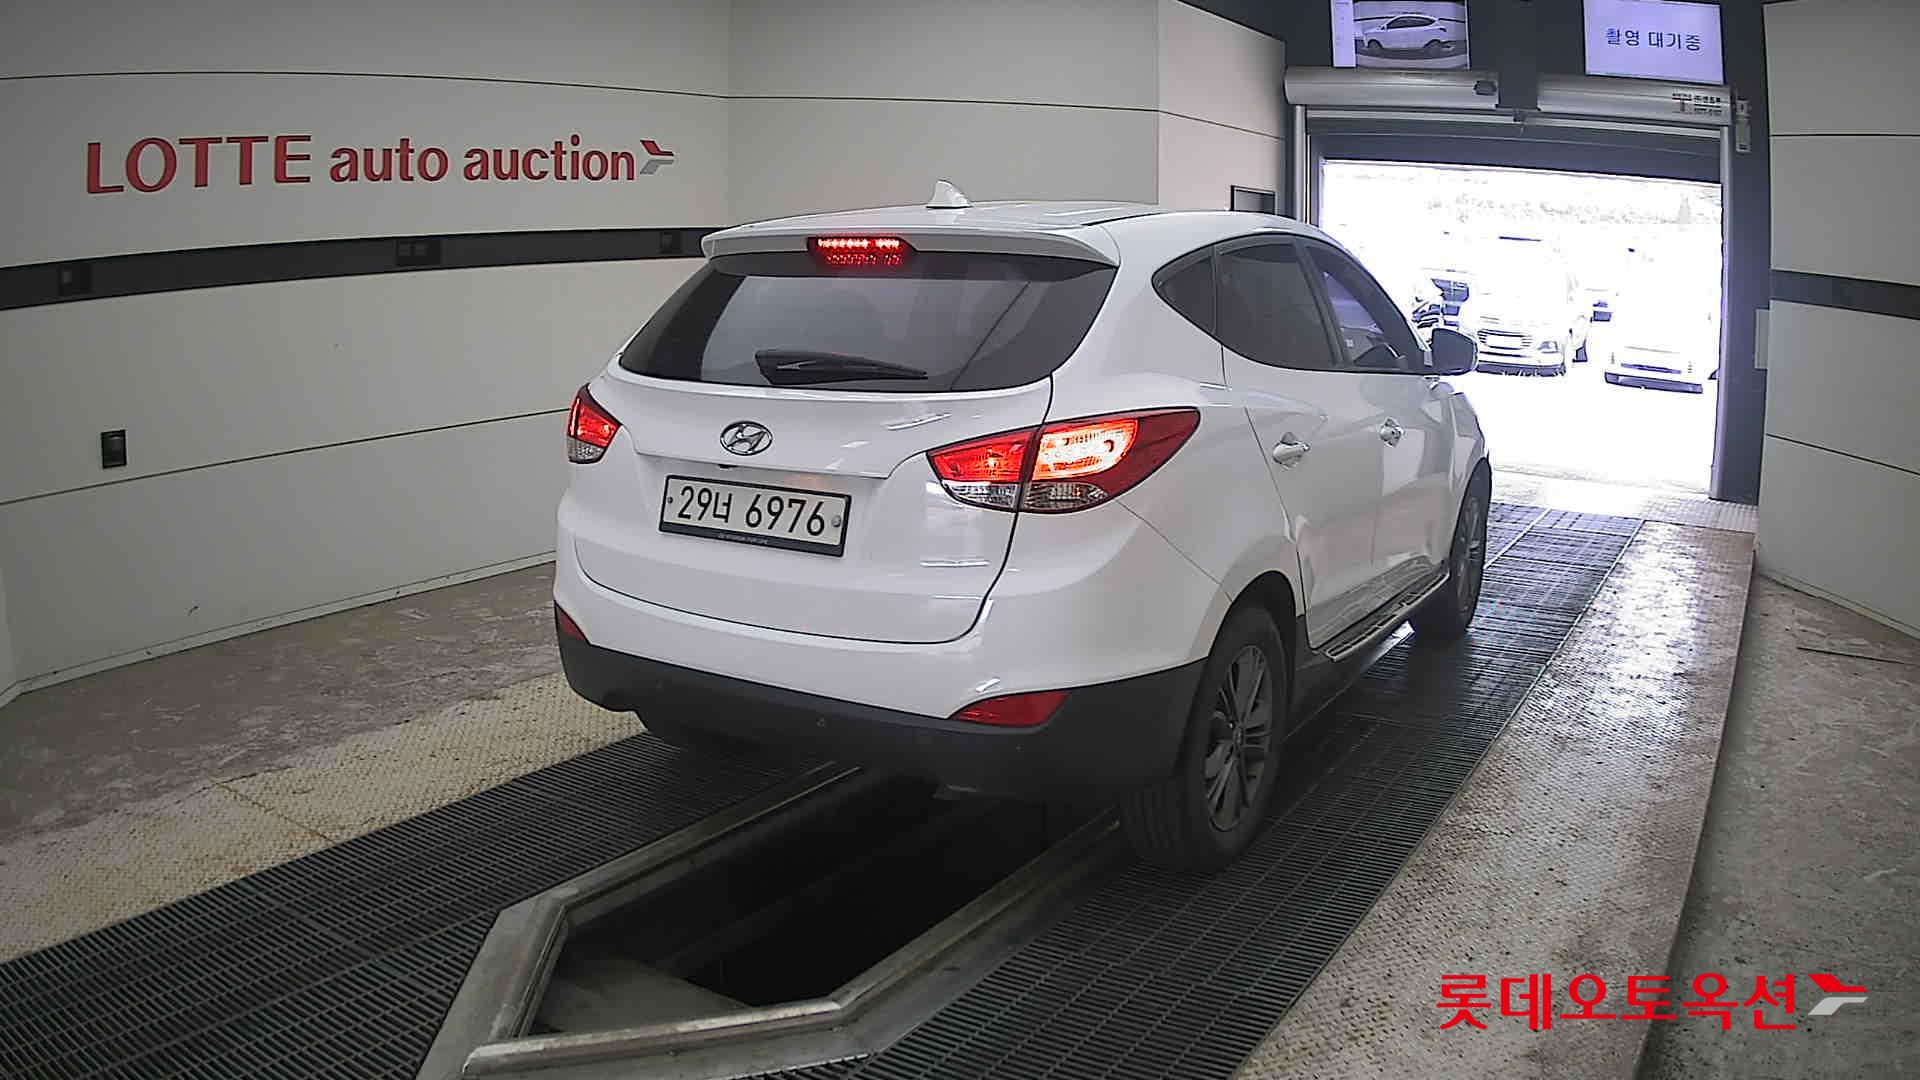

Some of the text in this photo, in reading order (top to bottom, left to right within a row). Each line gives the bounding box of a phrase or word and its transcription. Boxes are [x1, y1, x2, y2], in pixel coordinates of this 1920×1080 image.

[86, 133, 635, 194] LOTTE auto auction
[677, 485, 825, 536] 29너 6976
